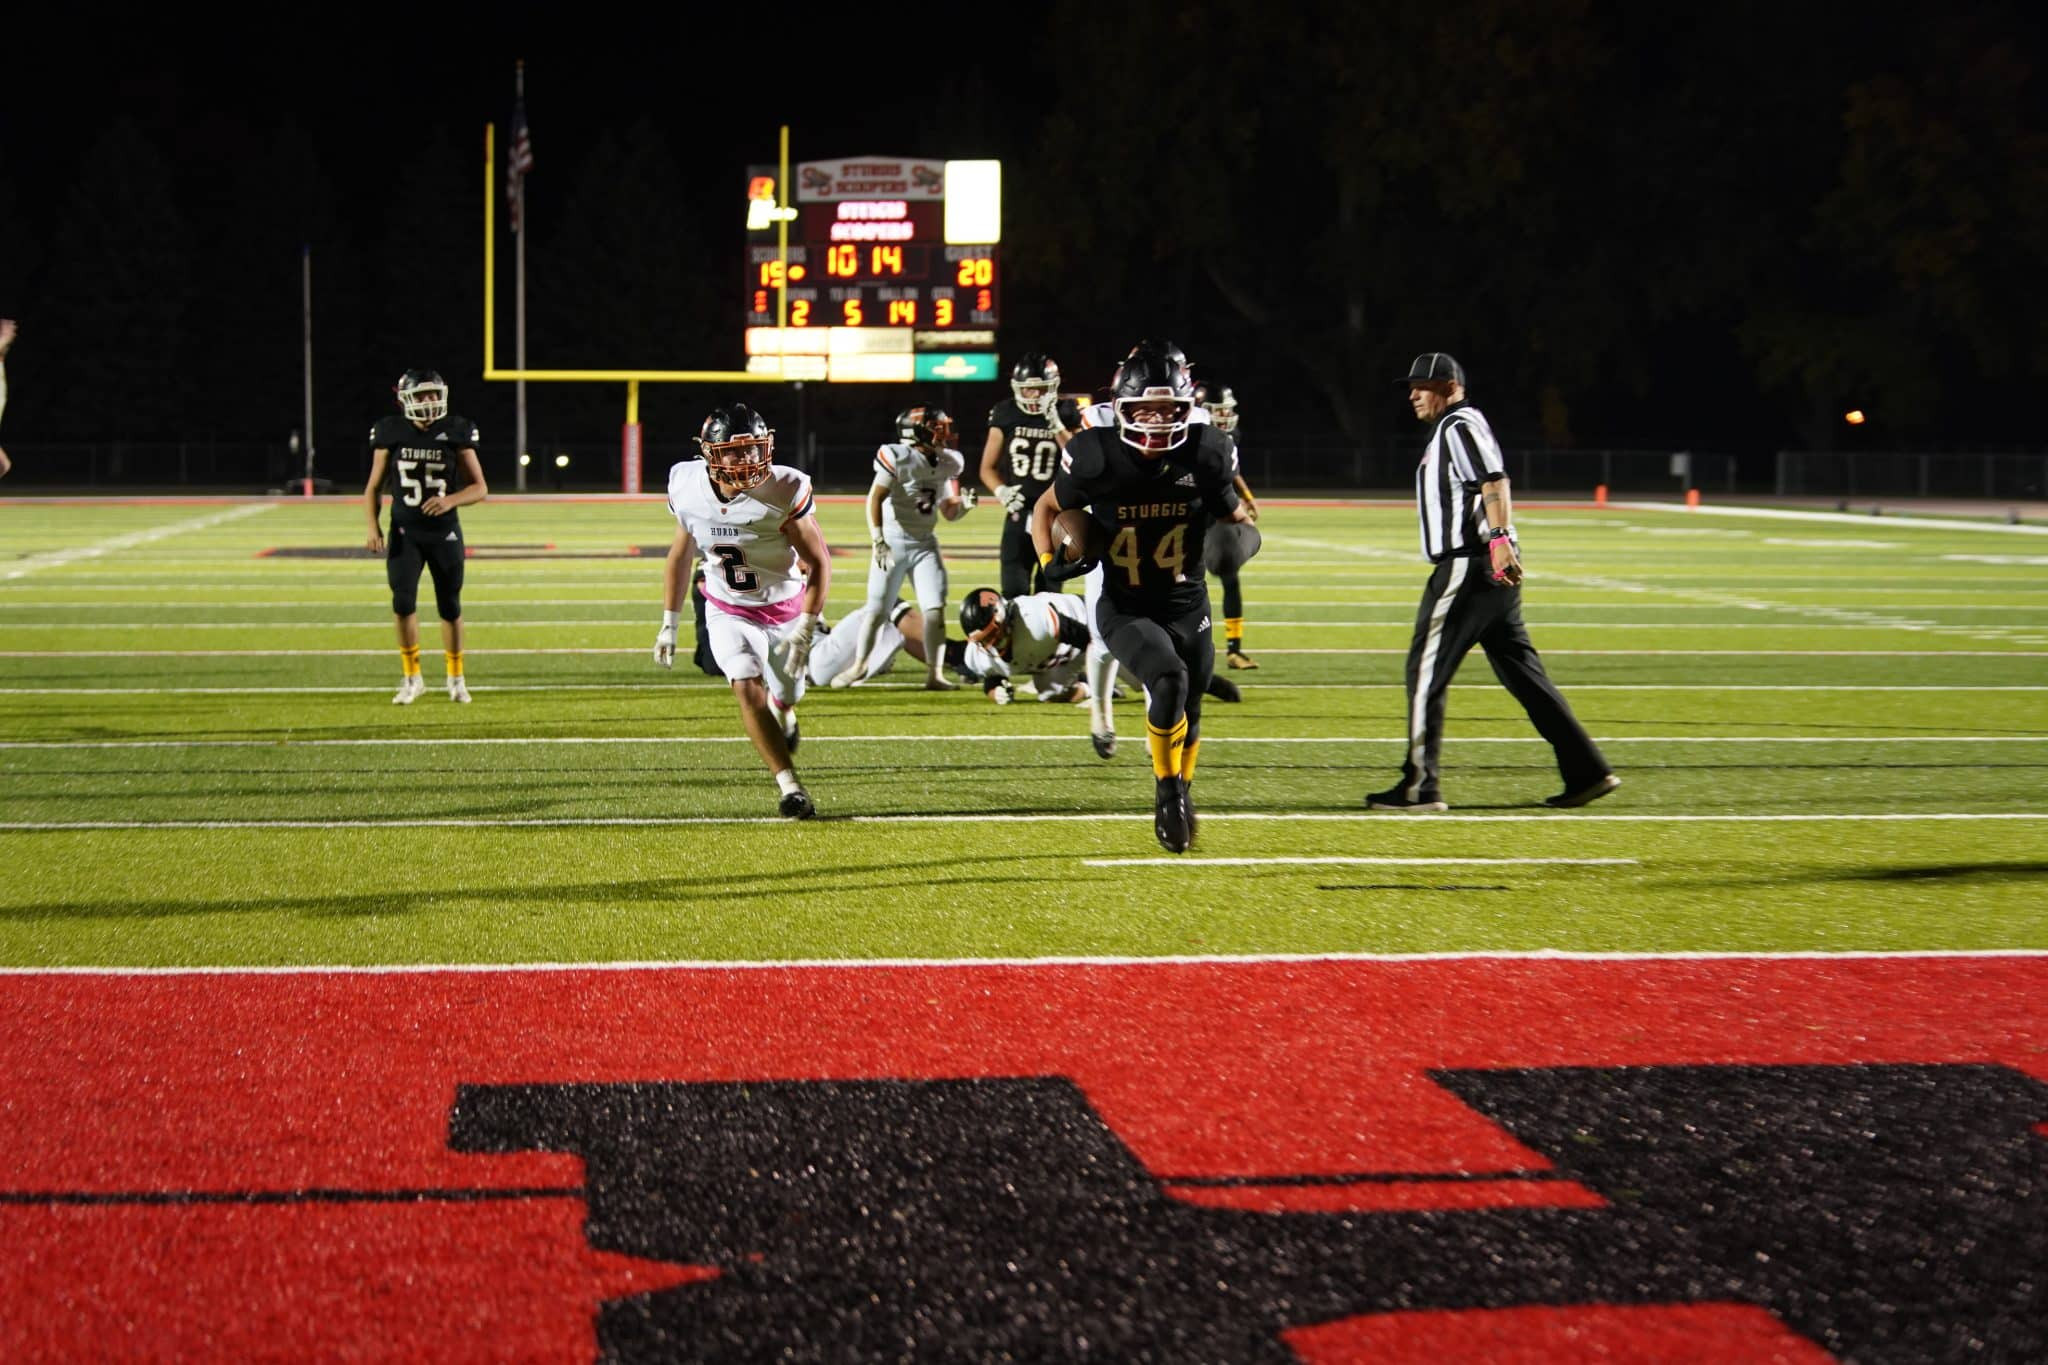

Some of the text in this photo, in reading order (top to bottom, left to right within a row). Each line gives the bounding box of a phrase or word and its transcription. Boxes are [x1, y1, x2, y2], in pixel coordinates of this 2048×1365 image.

[957, 258, 993, 286] 20
[792, 299, 810, 326] 2
[843, 298, 863, 326] 5
[889, 300, 916, 325] 14
[935, 298, 954, 327] 3
[1015, 426, 1054, 439] STURGIS
[401, 447, 442, 460] STURGIS
[1009, 437, 1058, 481] 60
[397, 459, 448, 507] 55
[1117, 503, 1188, 520] STURGIS
[710, 527, 739, 537] HURON
[710, 543, 762, 594] 2
[1108, 523, 1190, 586] 44
